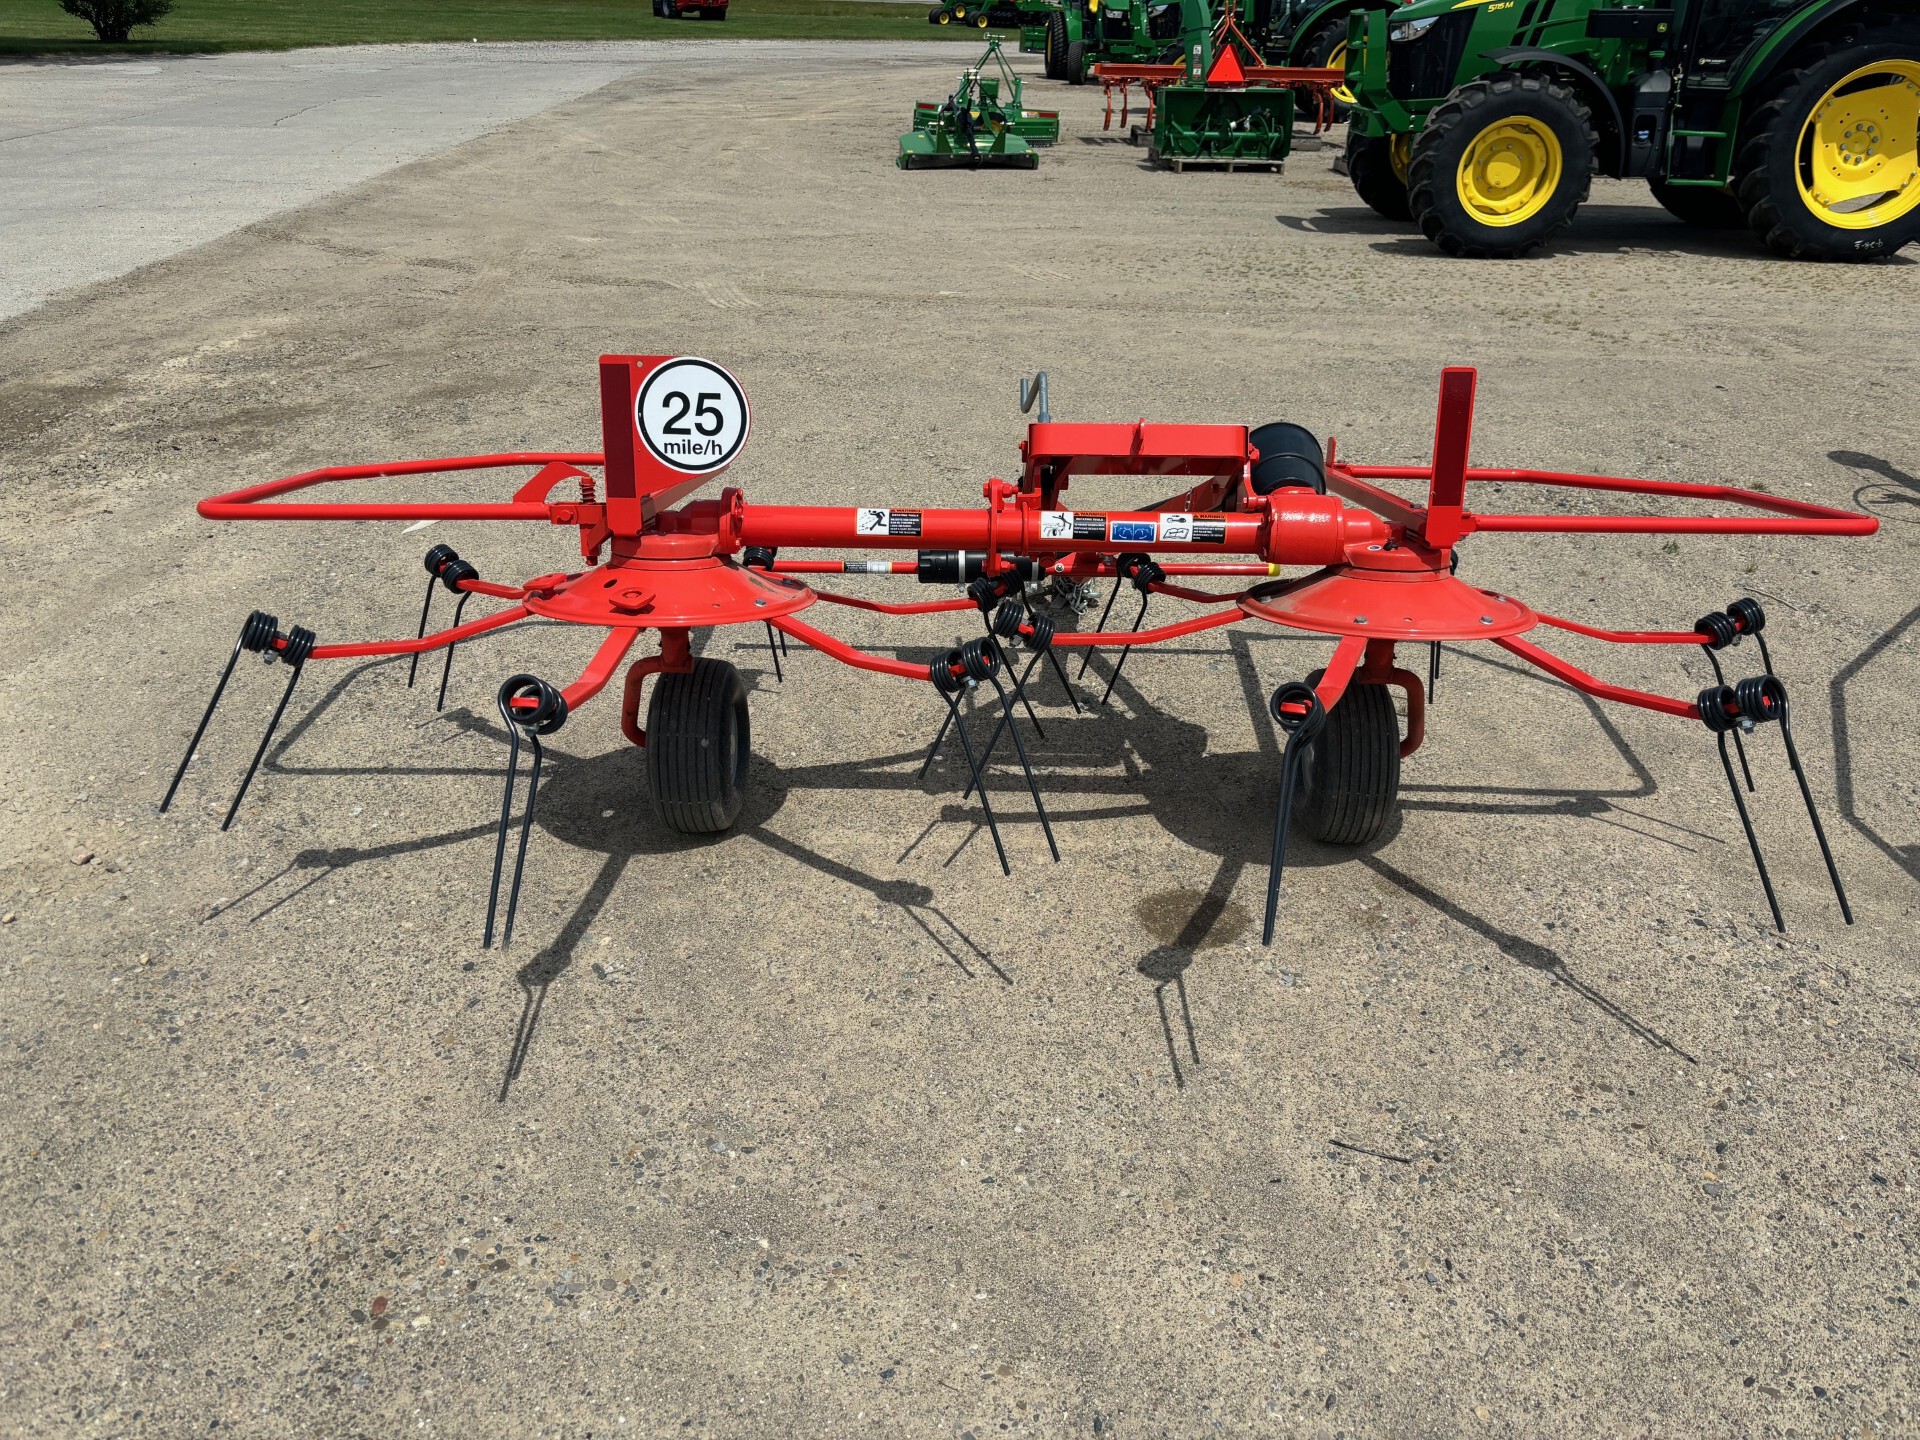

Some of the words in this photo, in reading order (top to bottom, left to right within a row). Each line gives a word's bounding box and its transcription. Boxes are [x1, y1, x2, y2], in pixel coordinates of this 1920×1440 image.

[1505, 1, 1514, 9] M
[662, 390, 724, 437] 25
[664, 439, 723, 456] mile/h
